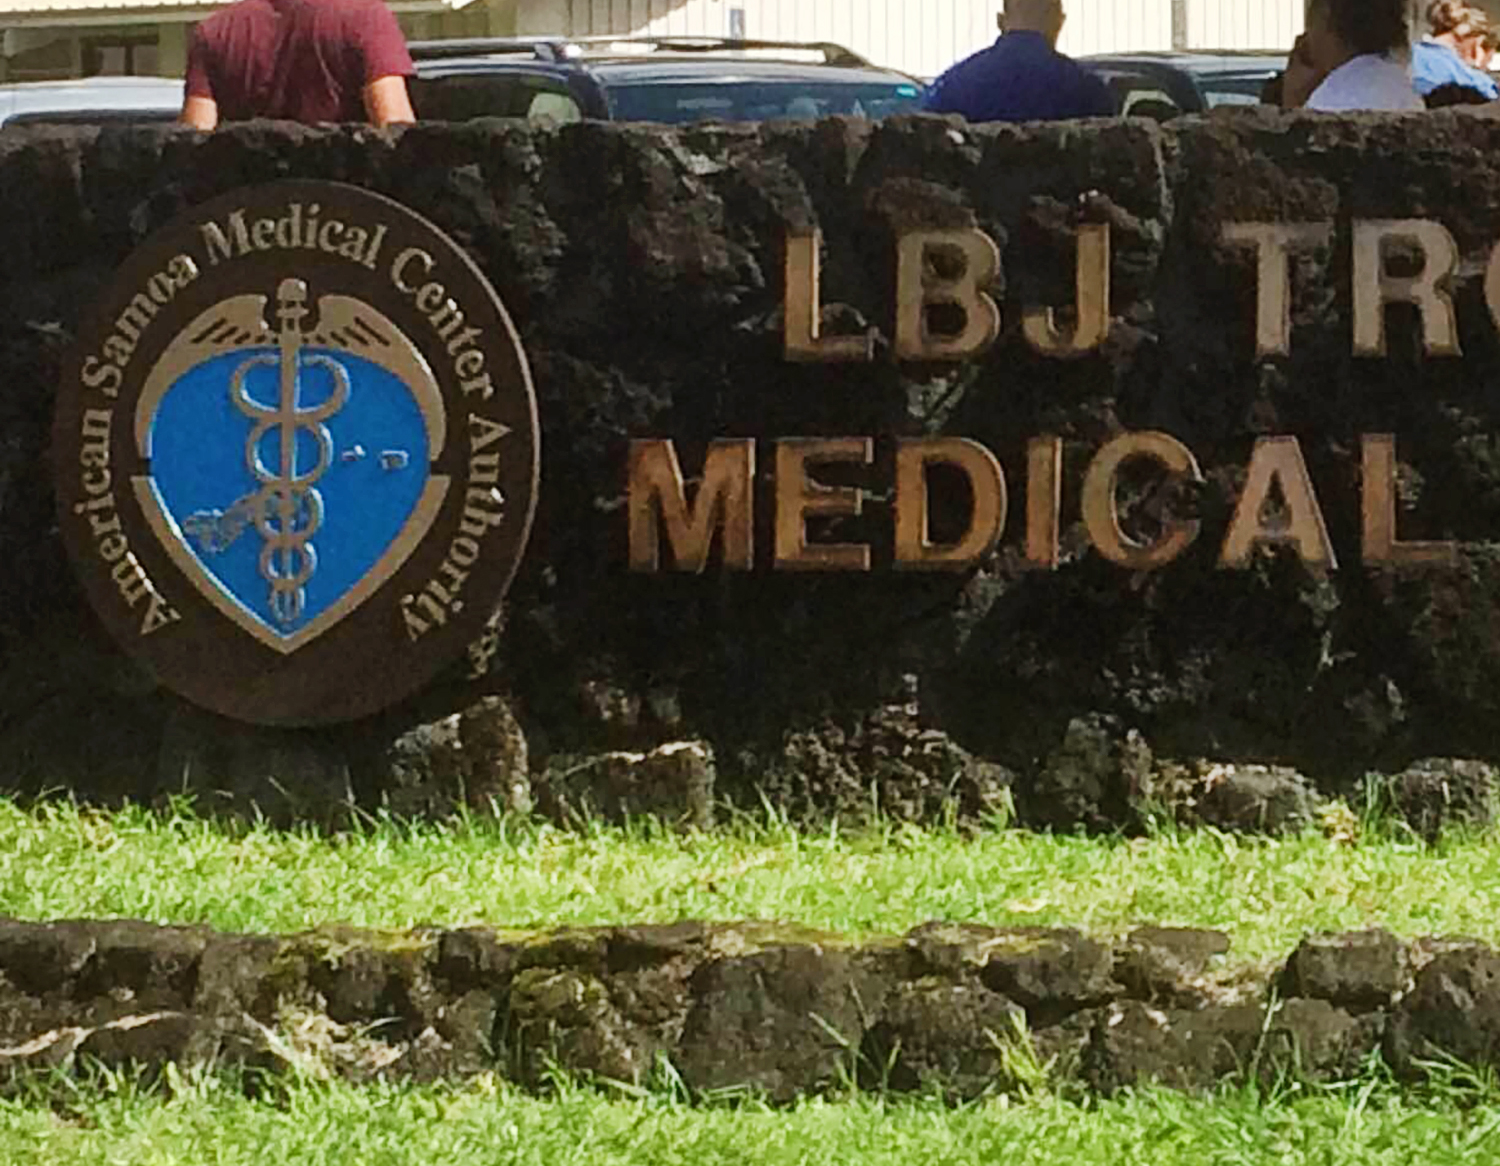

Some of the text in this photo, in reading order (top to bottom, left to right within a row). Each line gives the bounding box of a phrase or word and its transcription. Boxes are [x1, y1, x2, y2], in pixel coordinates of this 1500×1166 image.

[783, 222, 1112, 361] LBJ
[74, 203, 512, 641] American Samoa Medical Center Authority
[627, 432, 1458, 572] MEDICAL
